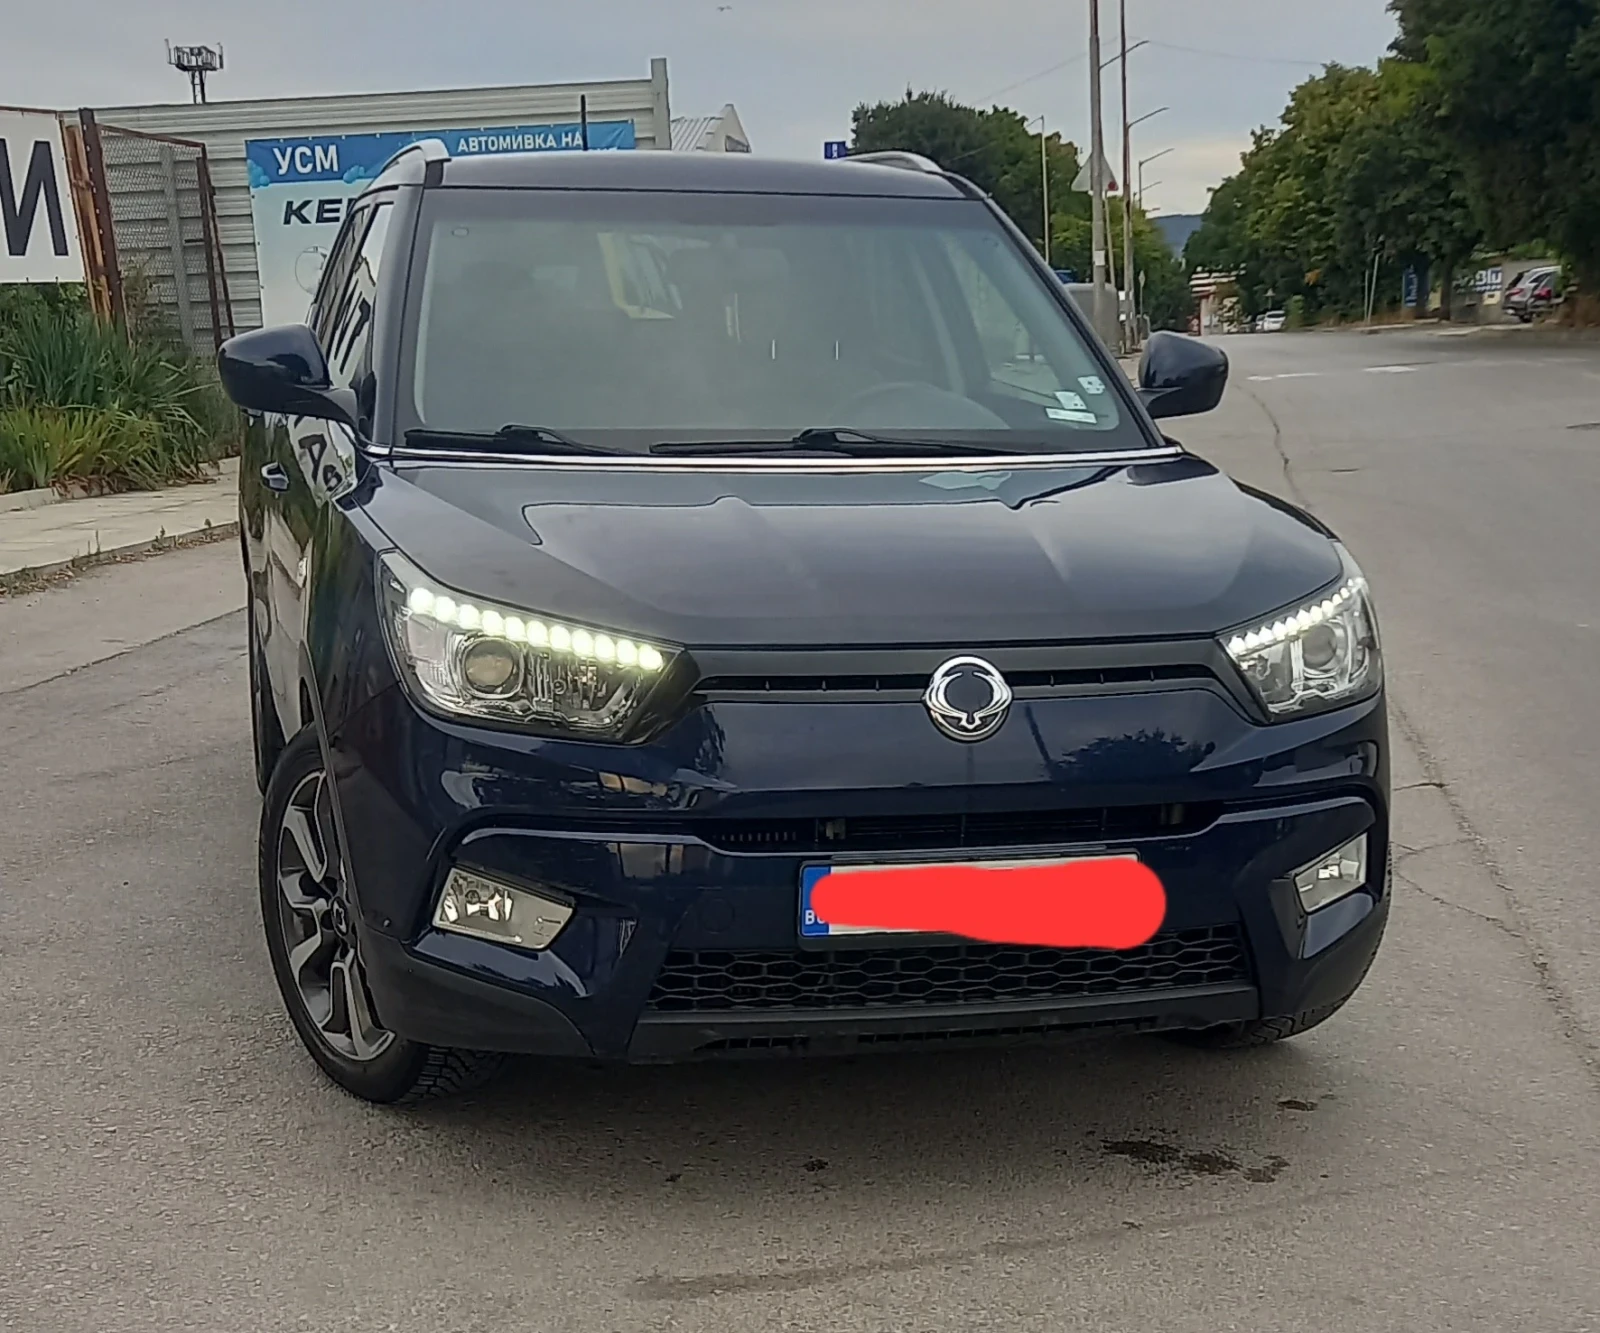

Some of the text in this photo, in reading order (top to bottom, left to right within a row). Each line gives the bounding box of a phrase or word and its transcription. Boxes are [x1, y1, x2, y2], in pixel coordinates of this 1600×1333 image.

[457, 131, 584, 153] АВТОМИВКА НА
[272, 144, 339, 175] УСМ
[283, 198, 357, 225] КЕ
